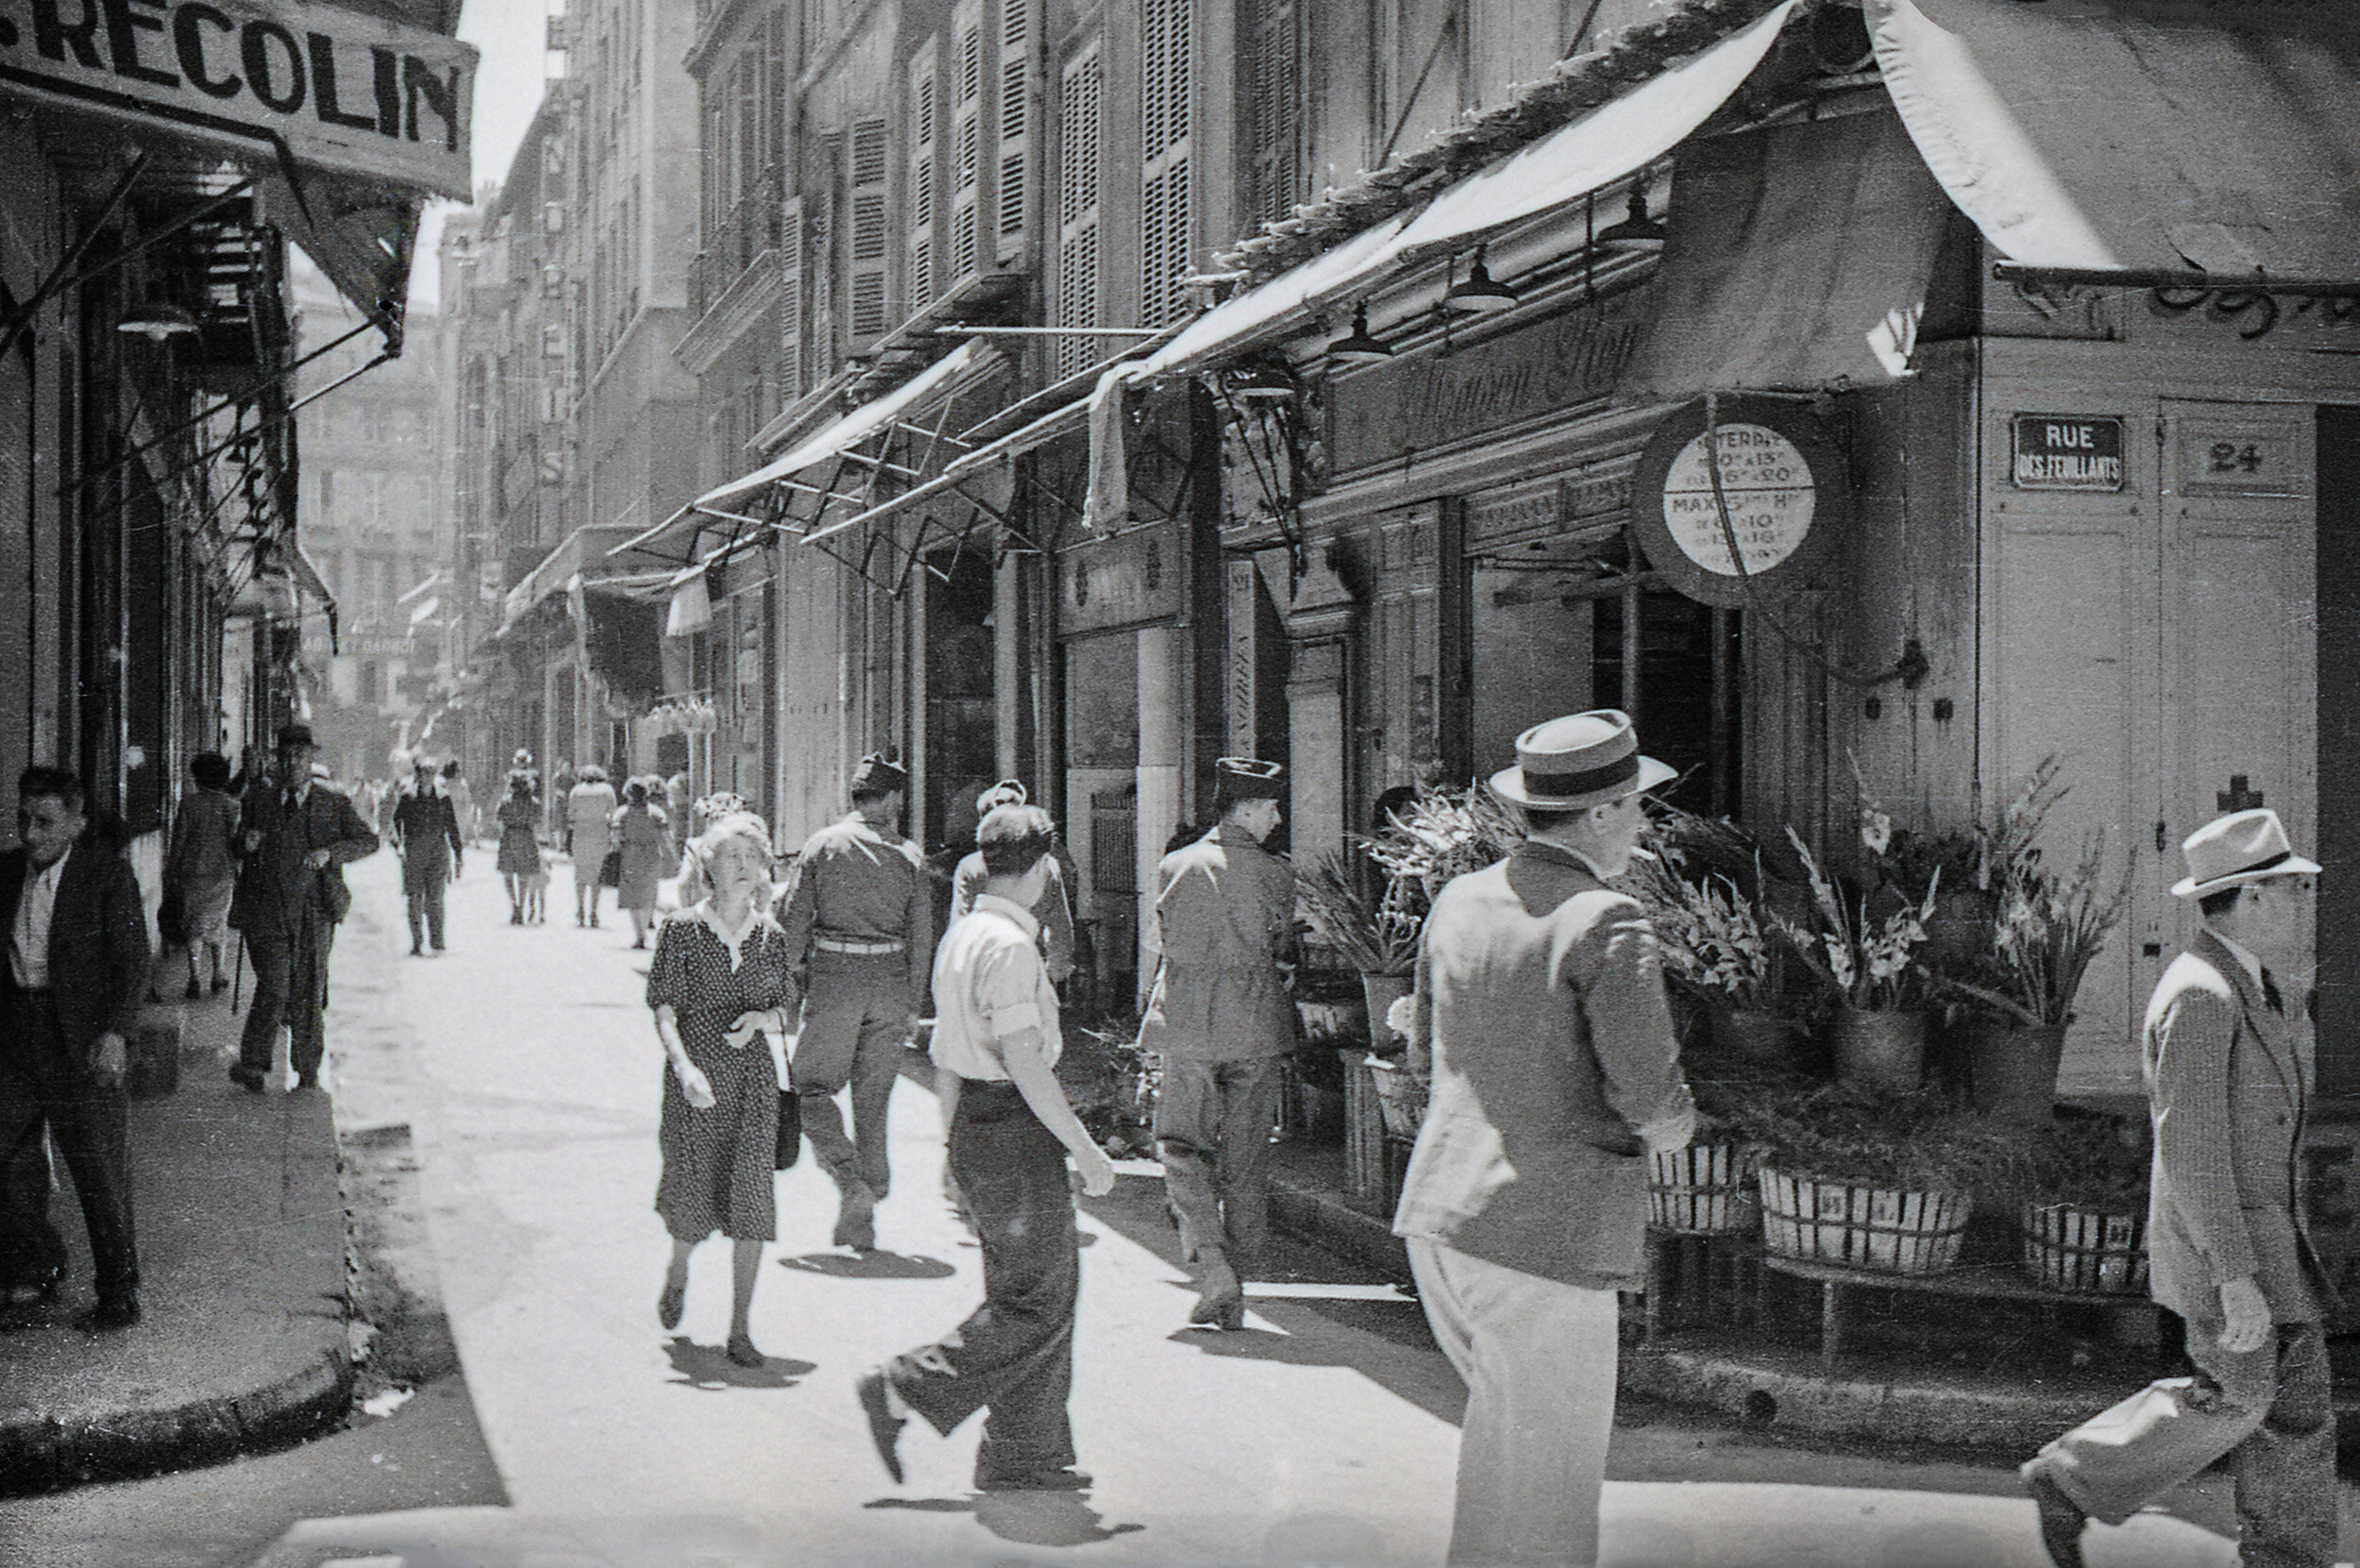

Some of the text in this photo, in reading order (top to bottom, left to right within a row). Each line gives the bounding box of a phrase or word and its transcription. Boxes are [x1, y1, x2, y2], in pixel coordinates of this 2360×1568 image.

[31, 0, 461, 152] RECOLIN
[2045, 424, 2095, 449] RUE
[2019, 455, 2044, 480] DES
[2209, 442, 2263, 472] 24
[1672, 497, 1712, 513] MAX
